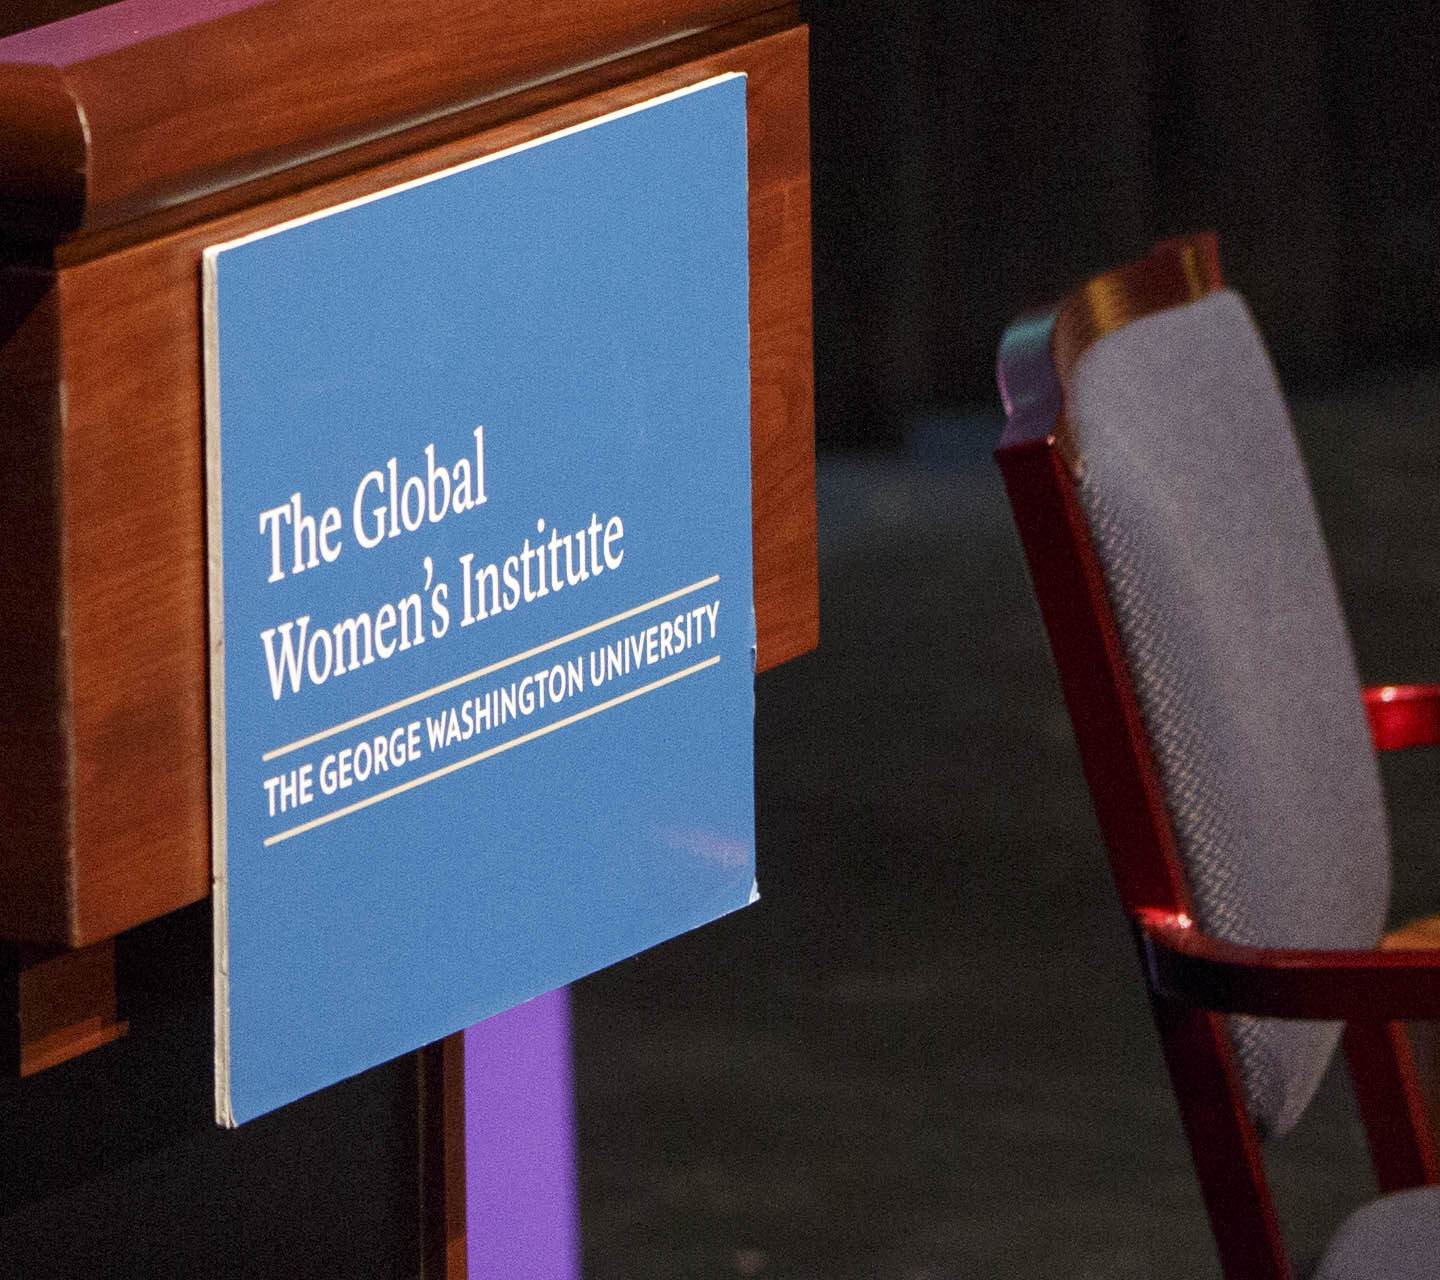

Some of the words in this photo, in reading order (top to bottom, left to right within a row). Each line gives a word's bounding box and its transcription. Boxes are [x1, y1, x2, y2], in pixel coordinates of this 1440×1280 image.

[259, 492, 343, 584] The
[352, 425, 488, 549] Global
[459, 512, 625, 628] Institute
[263, 763, 314, 817] THE
[319, 720, 422, 796] GEORGE
[425, 656, 584, 753] WASHINGTON
[590, 600, 720, 688] UNIVERSITY
